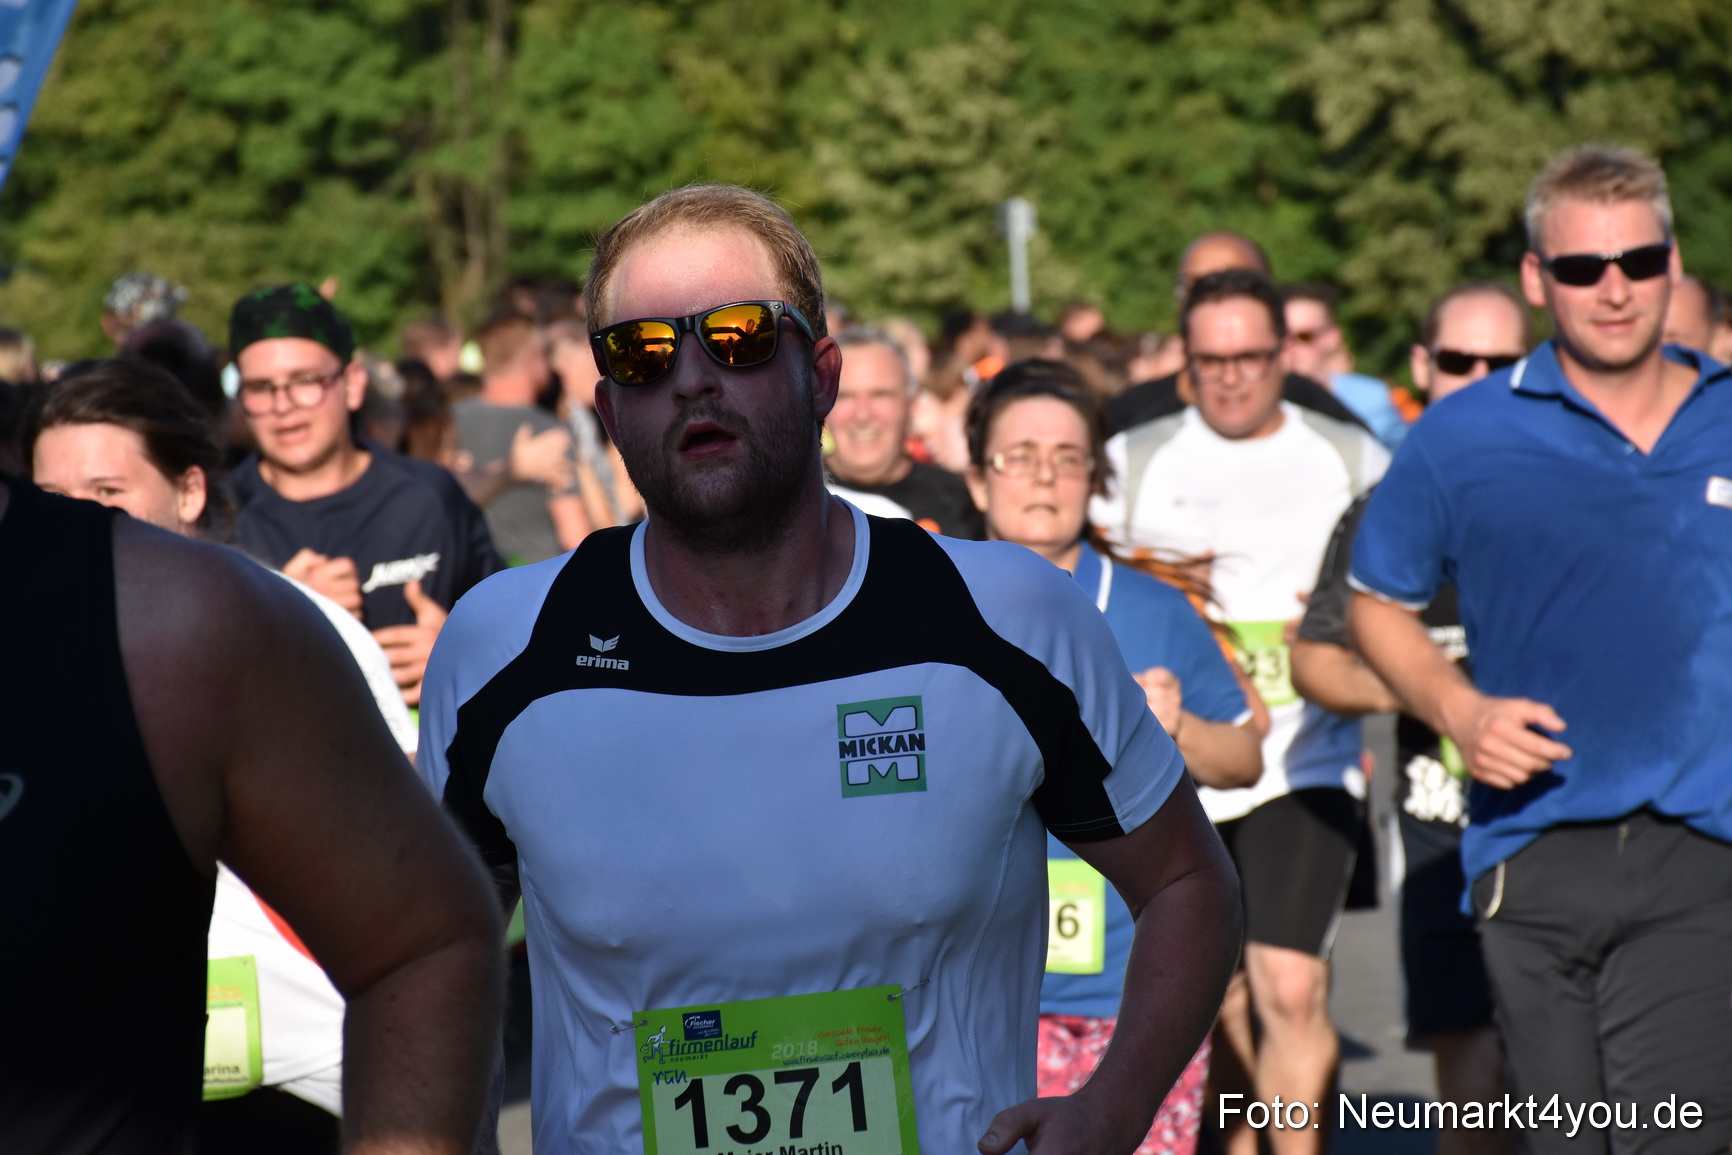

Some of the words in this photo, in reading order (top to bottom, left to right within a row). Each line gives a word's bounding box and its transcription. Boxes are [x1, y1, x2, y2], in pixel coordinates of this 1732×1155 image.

[575, 655, 630, 671] erima
[839, 733, 926, 759] MICKAN
[669, 1031, 758, 1056] firmenlauf
[771, 1040, 818, 1060] 2018
[670, 1053, 708, 1063] neumarkt
[674, 1061, 868, 1149] 1371
